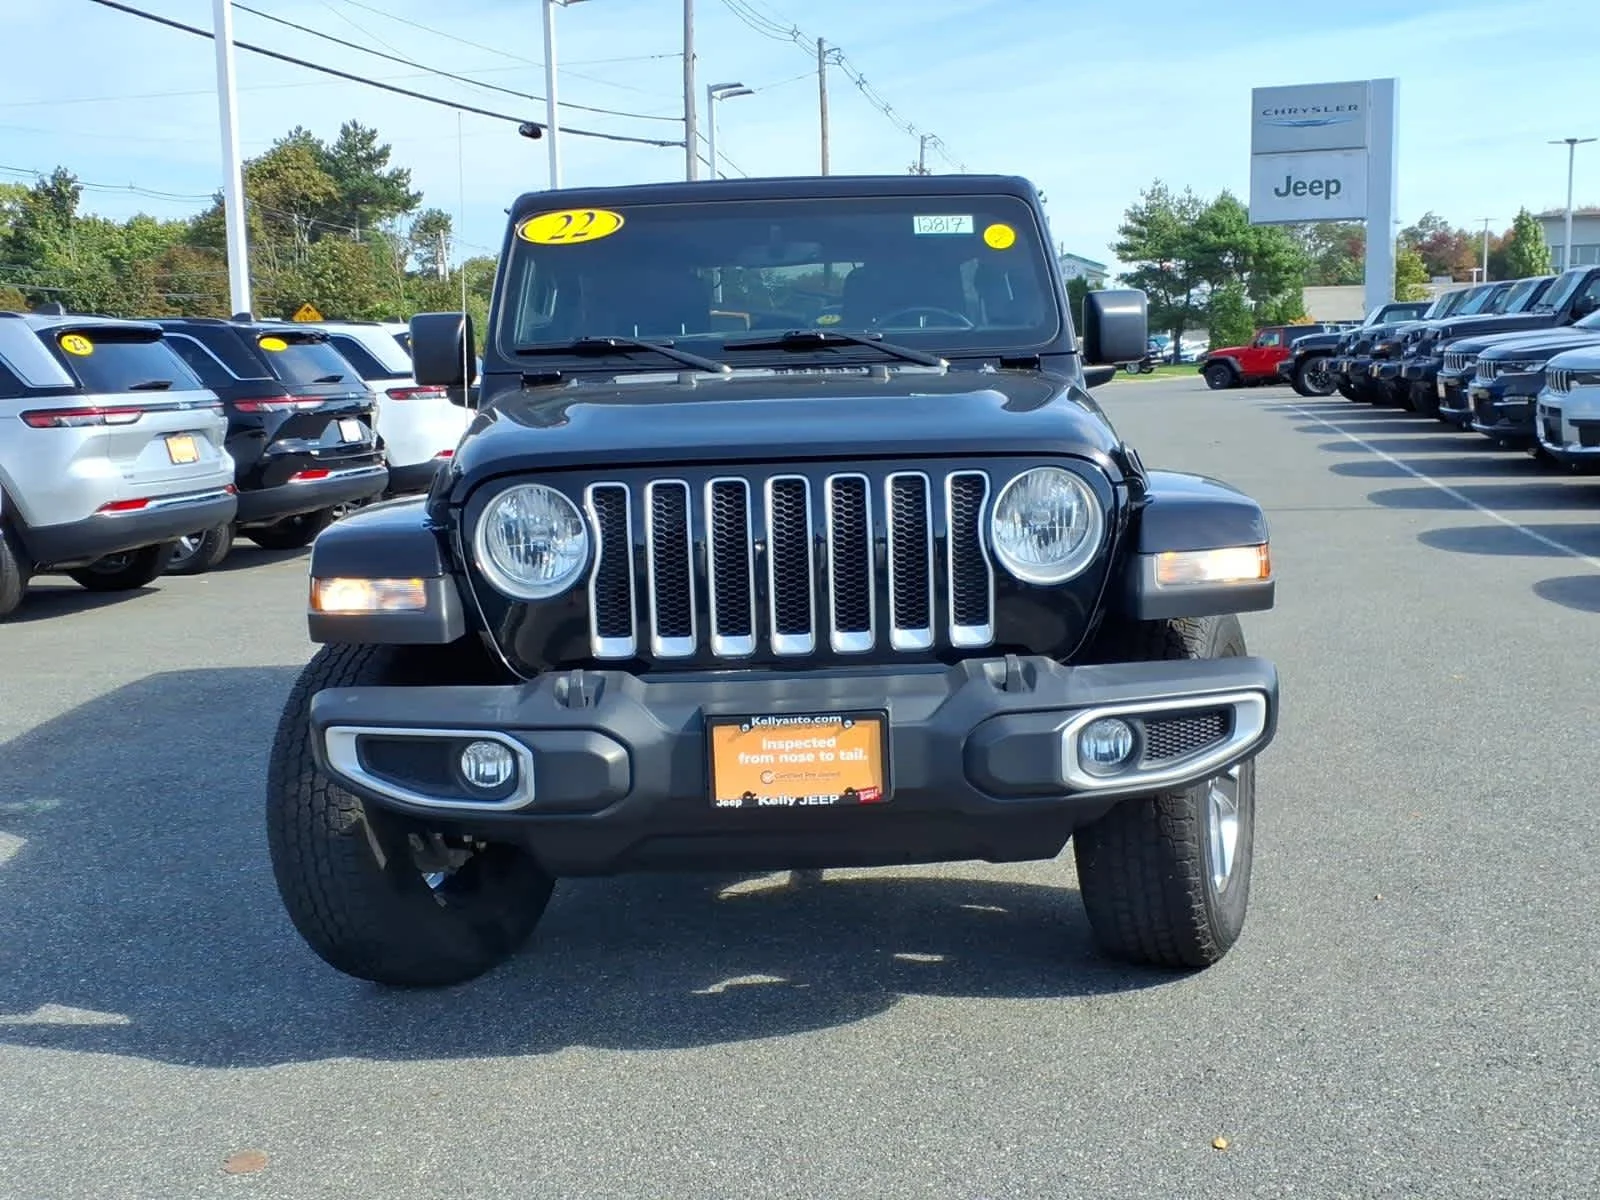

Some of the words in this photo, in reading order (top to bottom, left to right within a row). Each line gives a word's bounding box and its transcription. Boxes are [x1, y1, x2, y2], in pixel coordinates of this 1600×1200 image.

[1262, 103, 1358, 116] CHRYSLER
[1273, 175, 1342, 200] Jeep
[547, 211, 596, 241] 22
[918, 216, 966, 232] 12817
[751, 715, 842, 727] Kellyauto.com
[762, 736, 836, 752] Inspected
[737, 752, 774, 765] from
[779, 751, 815, 764] nose
[819, 750, 834, 762] to
[839, 748, 868, 761] tail.
[716, 799, 743, 808] Jeep
[758, 795, 797, 807] Kelly
[799, 794, 839, 805] JEEP
